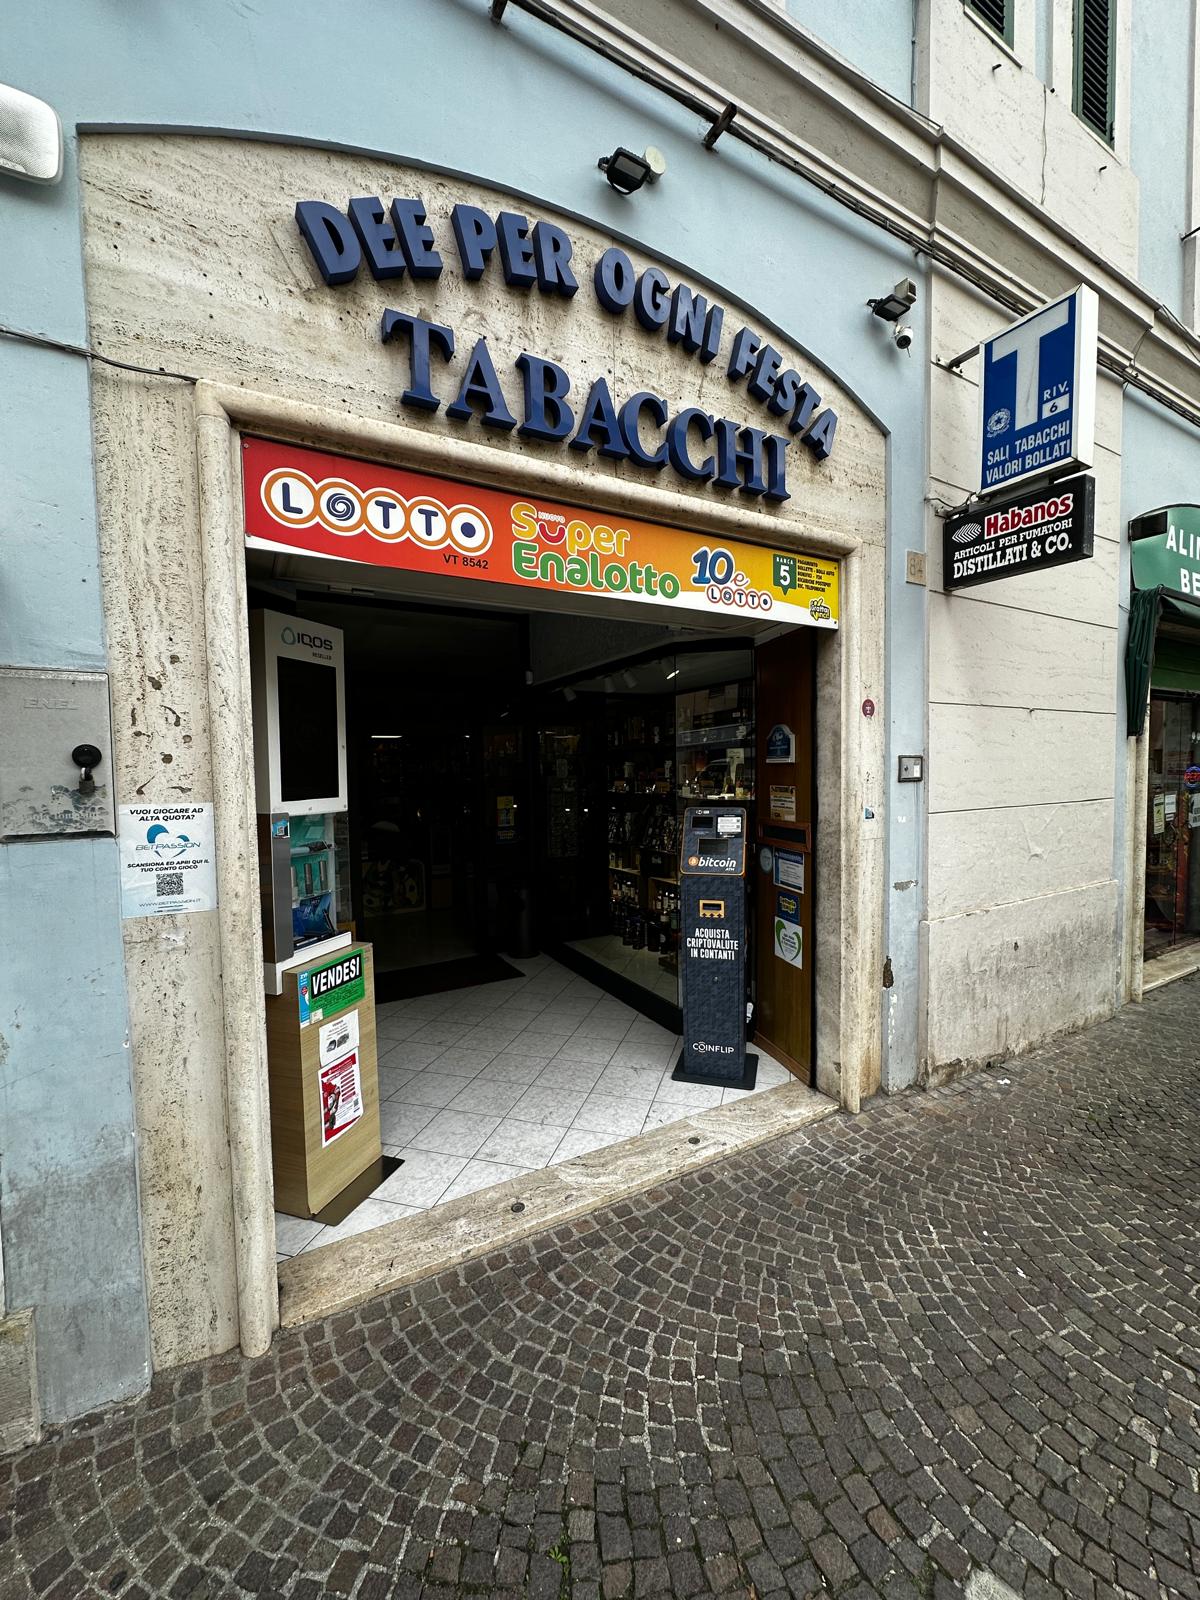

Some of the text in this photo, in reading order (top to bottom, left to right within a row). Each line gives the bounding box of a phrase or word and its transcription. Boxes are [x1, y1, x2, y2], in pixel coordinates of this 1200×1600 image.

[296, 197, 838, 460] DEE PER OGNI FESTA
[1043, 381, 1069, 400] RIV.
[380, 308, 791, 501] TABACCHI
[1050, 402, 1058, 413] 6
[987, 420, 1070, 466] SALI TABACCHI
[986, 439, 1071, 484] VALORI BOLLATI
[270, 475, 484, 547] LOTTO
[985, 493, 1073, 539] Habanos
[511, 502, 631, 556] Super
[953, 518, 1073, 560] ARTICOLI PER FUMATORI
[443, 553, 489, 569] VT 8542
[953, 532, 1073, 578] DISTILLATI & CO.
[512, 541, 680, 600] Enalotto
[779, 565, 791, 586] 5
[709, 586, 770, 610] LOTTO
[297, 632, 333, 650] IQOS
[135, 842, 201, 851] BETPASSION
[698, 856, 736, 868] bitcoin
[686, 937, 739, 950] CRIPTOVALUTE
[695, 928, 730, 939] ACQUISTA
[690, 948, 735, 961] IN CONTANTI
[312, 956, 360, 995] VENDESI
[692, 1041, 735, 1054] COINFLIP
